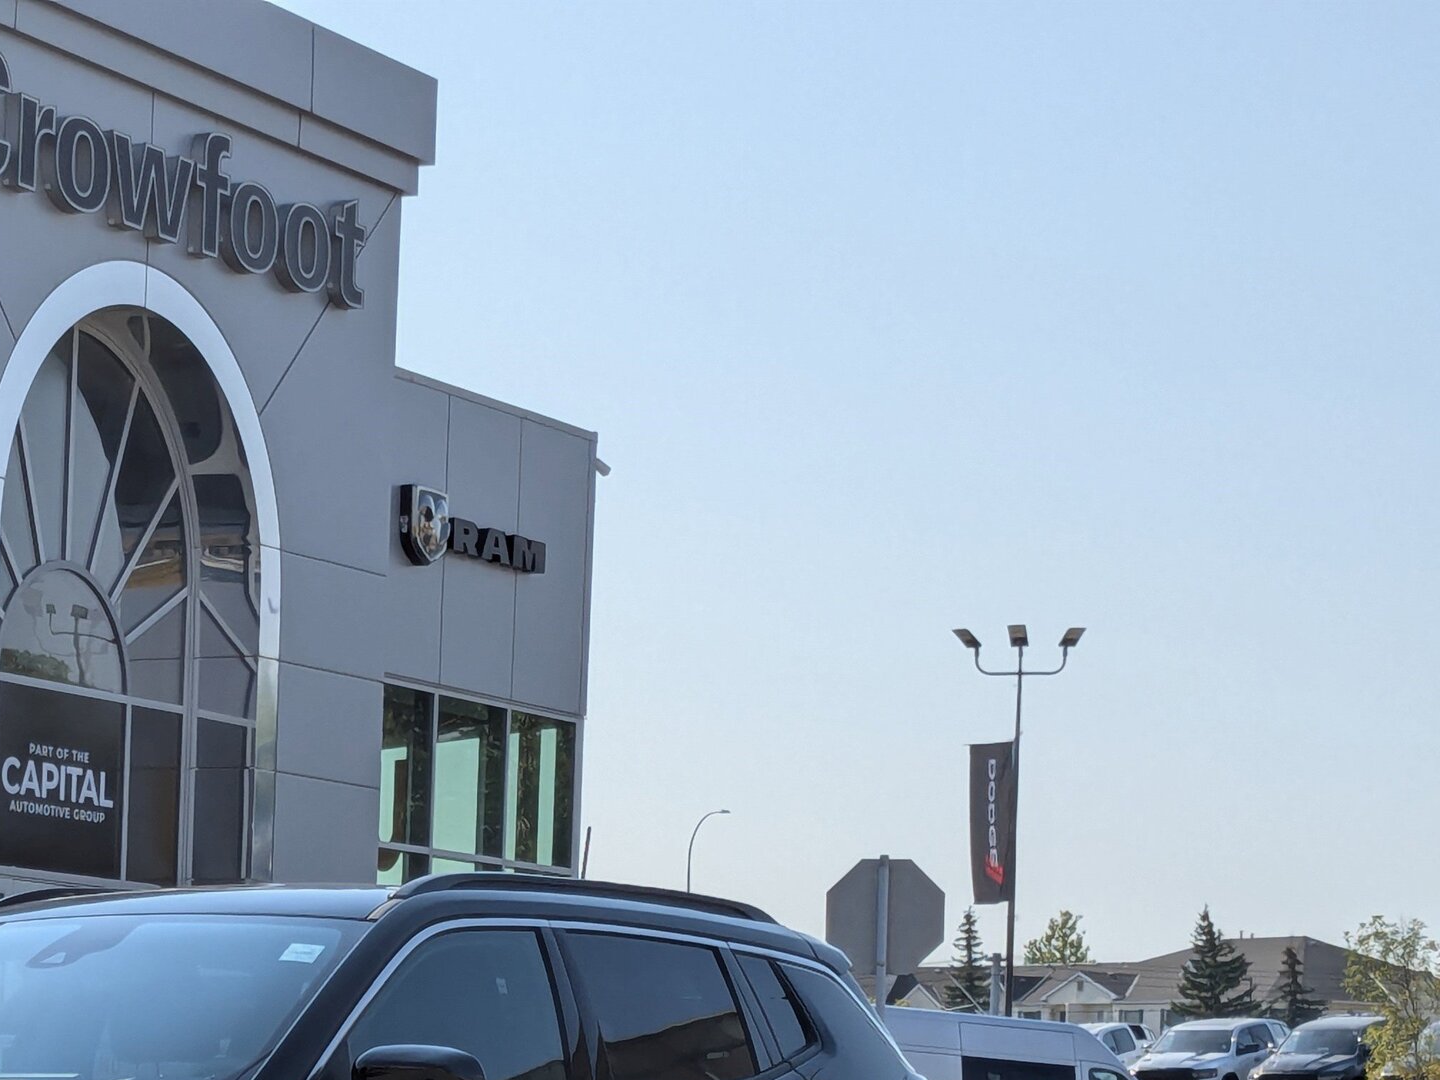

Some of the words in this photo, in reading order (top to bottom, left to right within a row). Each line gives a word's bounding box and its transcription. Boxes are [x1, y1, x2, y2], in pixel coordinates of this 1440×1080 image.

[450, 517, 547, 574] RAM
[29, 742, 54, 758] PART
[56, 747, 70, 760] OF
[72, 750, 90, 764] THE
[1, 756, 114, 809] CAPITAL
[9, 800, 71, 819] AUTOMOTIVE
[73, 808, 106, 823] GROUP
